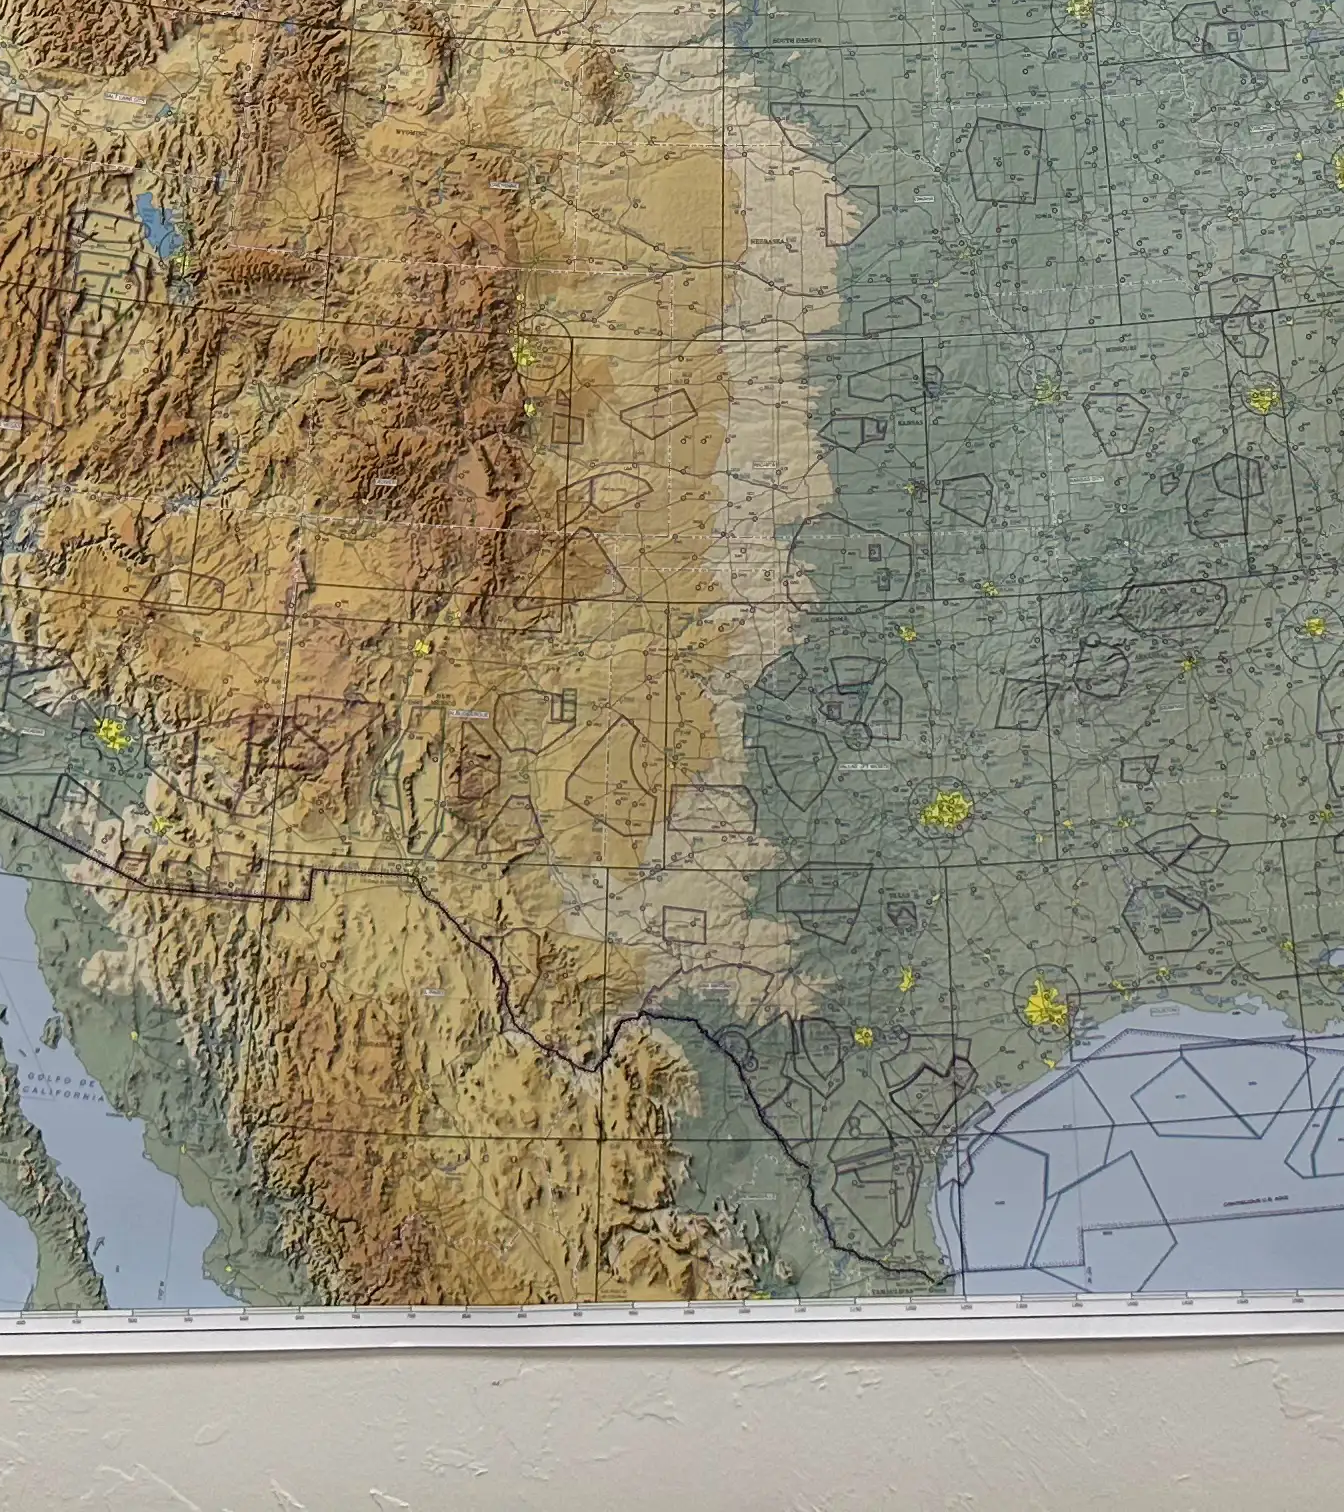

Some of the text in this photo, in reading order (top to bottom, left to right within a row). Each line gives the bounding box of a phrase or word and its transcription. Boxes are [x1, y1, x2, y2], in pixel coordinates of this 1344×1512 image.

[27, 1072, 96, 1088] GOLFO DE
[23, 1085, 105, 1102] CALIFORNIA
